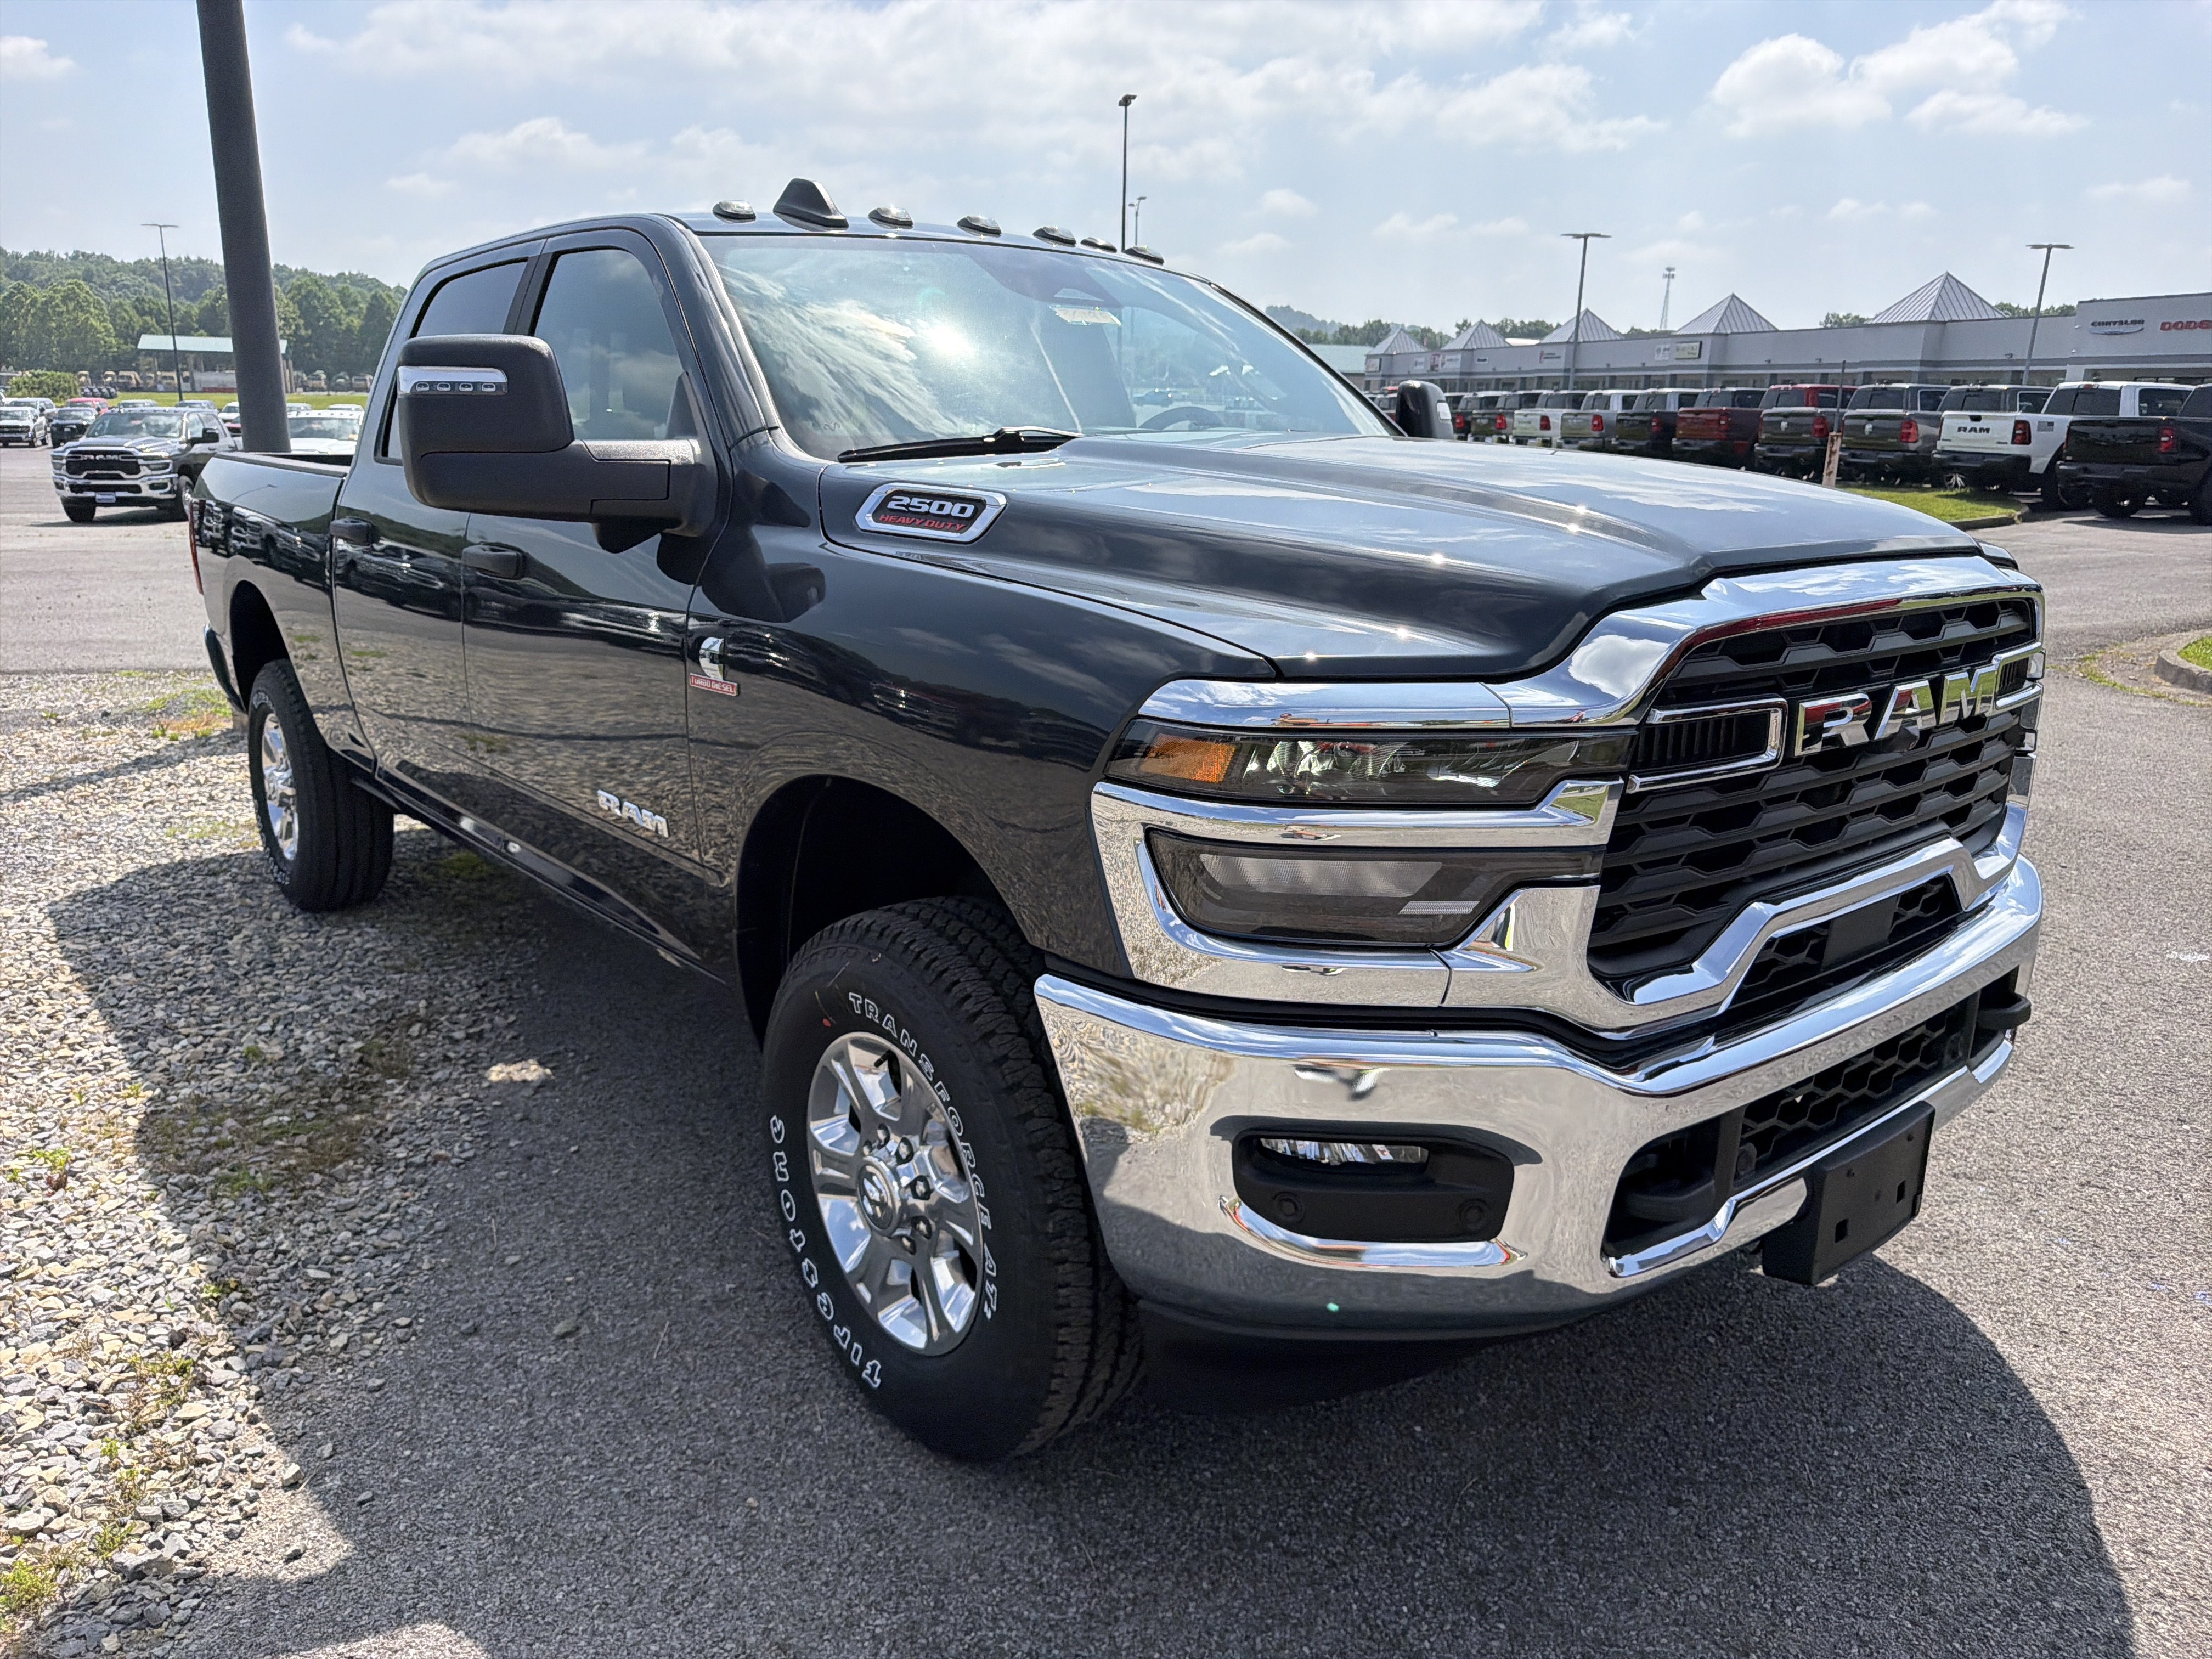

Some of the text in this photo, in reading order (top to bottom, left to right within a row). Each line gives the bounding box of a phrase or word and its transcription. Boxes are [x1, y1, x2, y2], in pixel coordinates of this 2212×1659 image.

[2160, 320, 2212, 331] DODG
[887, 496, 975, 518] 2500
[879, 515, 966, 532] HEAVY DUTY
[691, 676, 735, 693] TURBO DIESEL
[1794, 665, 1997, 757] RAM
[597, 789, 669, 838] RAM
[849, 992, 992, 1230] TRANSFORCE
